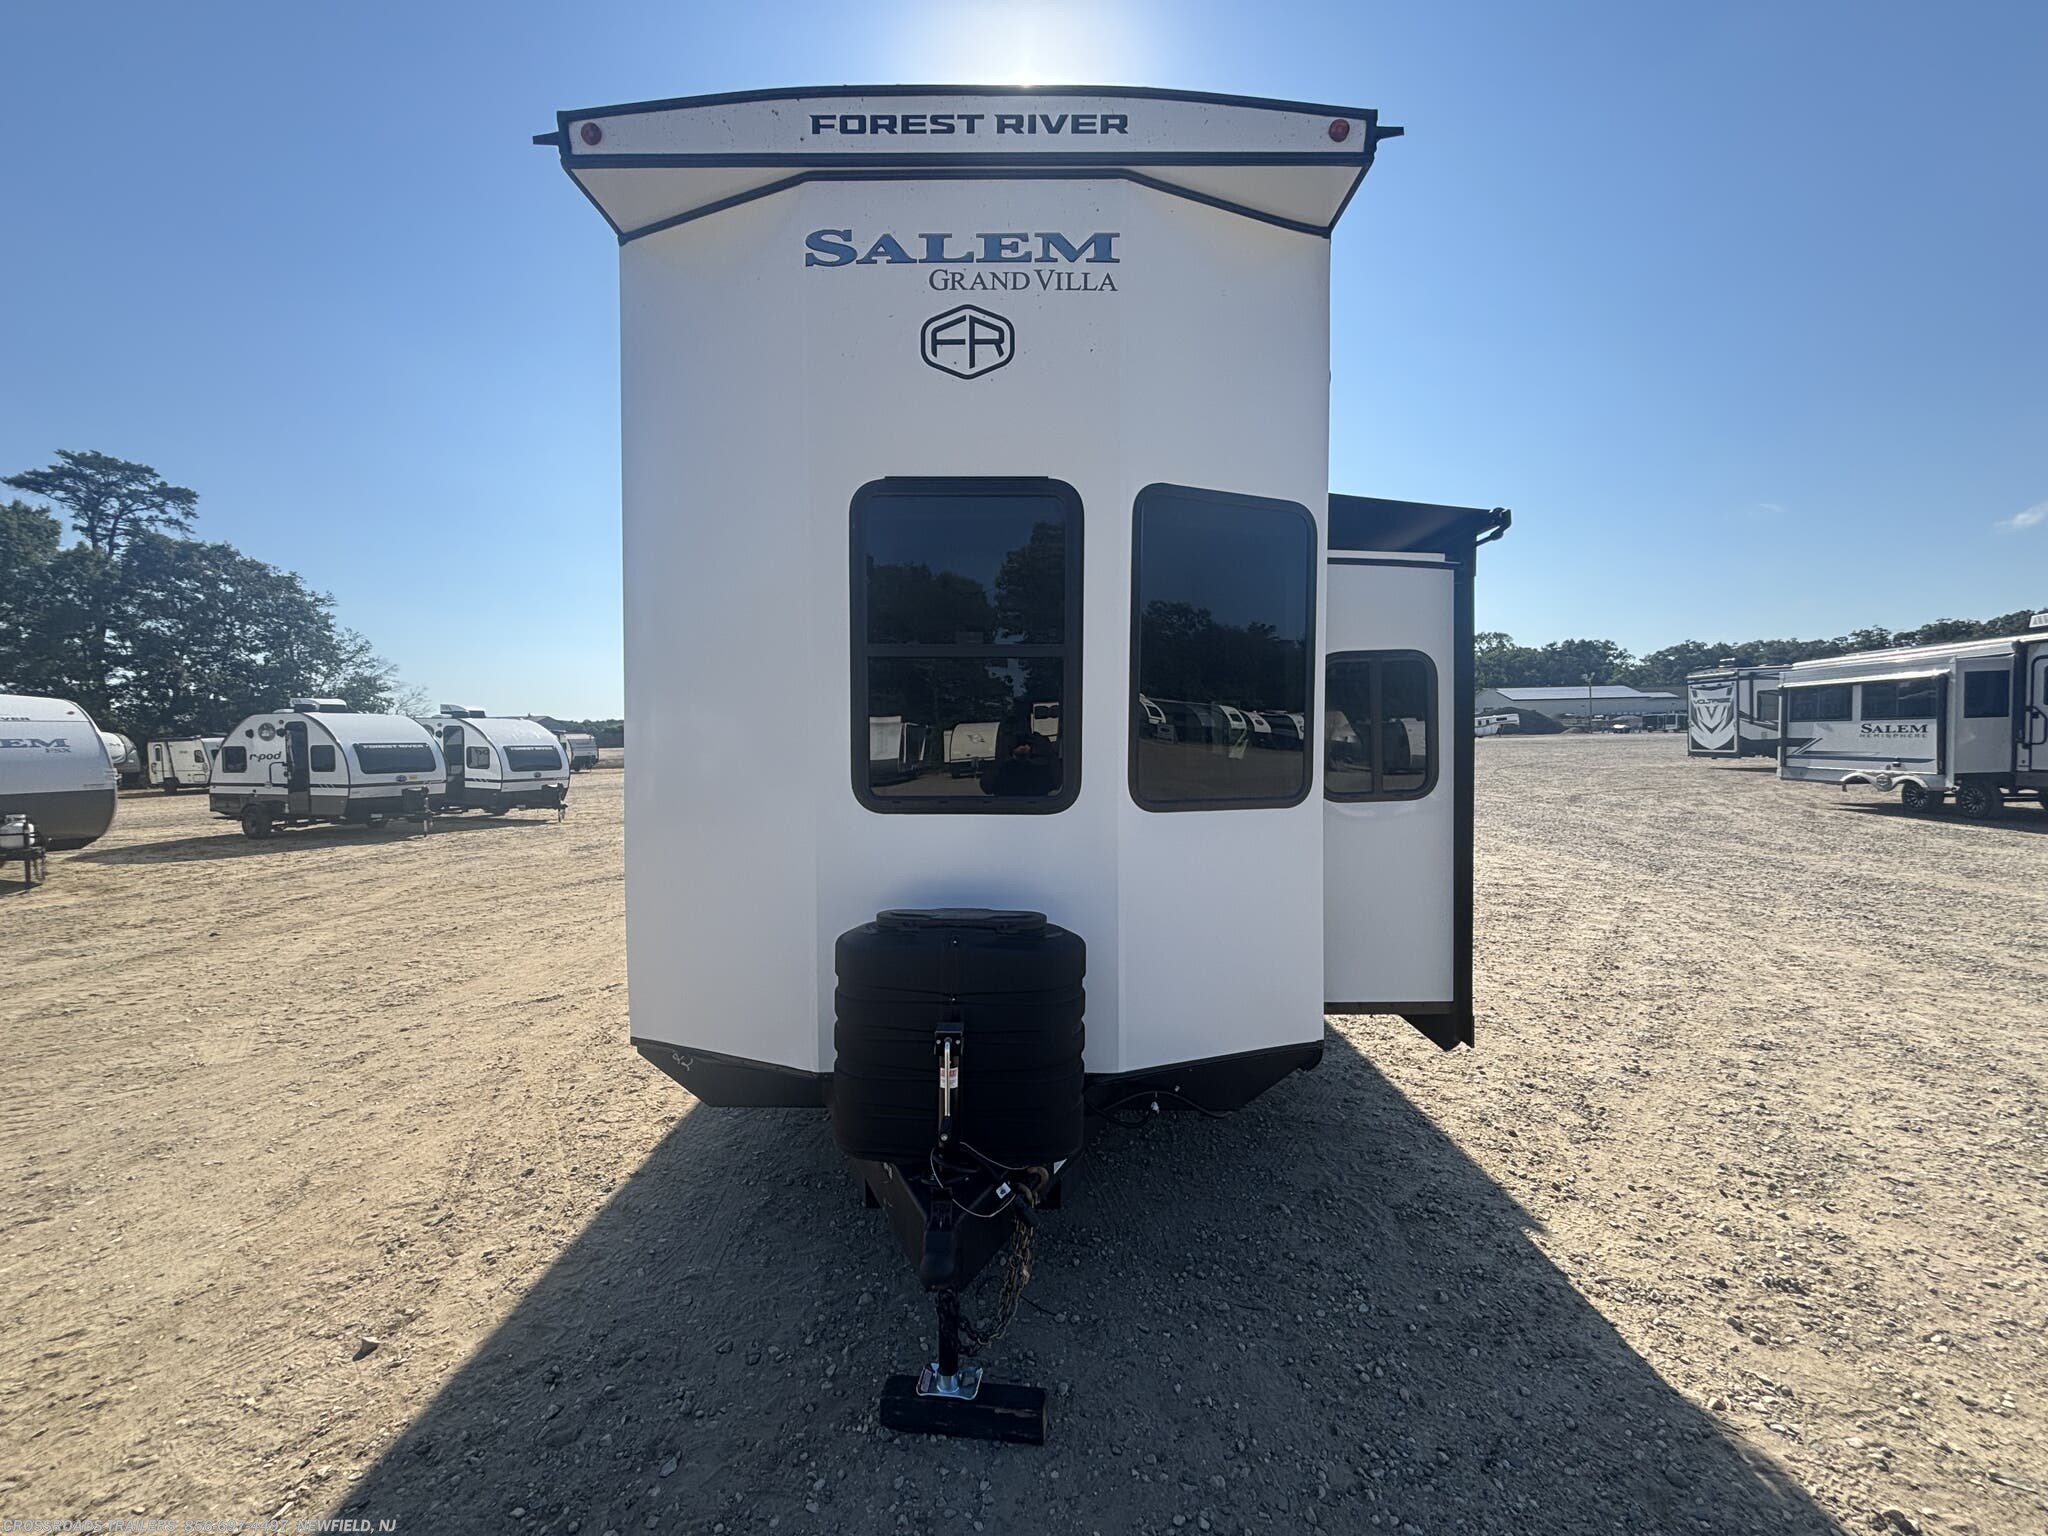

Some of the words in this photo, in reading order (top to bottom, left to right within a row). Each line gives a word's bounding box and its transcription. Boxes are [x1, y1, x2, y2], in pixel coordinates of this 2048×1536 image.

[809, 114, 984, 135] FOREST
[995, 114, 1129, 135] RIVER
[805, 229, 1121, 267] SALEM
[929, 269, 1030, 291] GRAND
[1036, 269, 1119, 291] VILLA
[1860, 723, 1929, 734] SALEM
